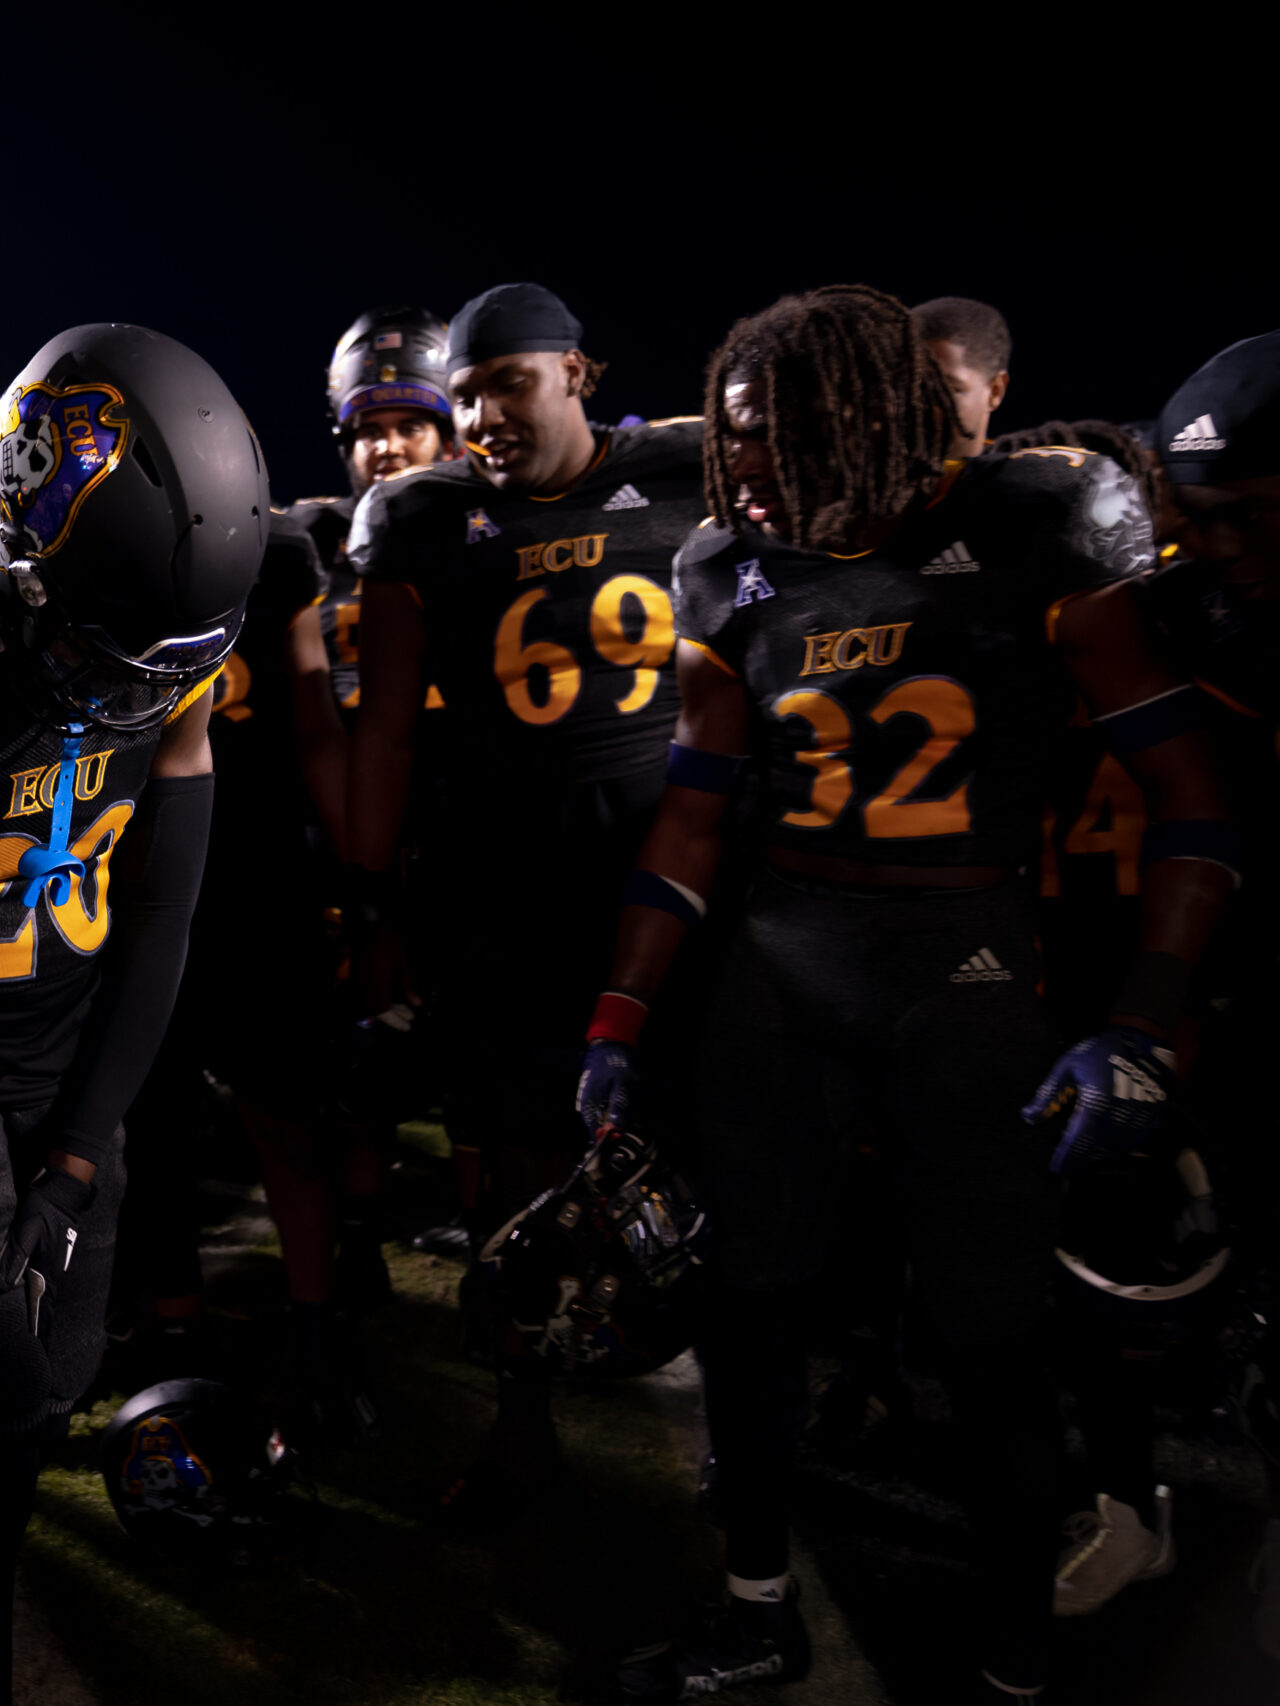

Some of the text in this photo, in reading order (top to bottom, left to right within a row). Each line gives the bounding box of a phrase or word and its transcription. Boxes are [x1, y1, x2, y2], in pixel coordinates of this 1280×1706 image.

[372, 387, 438, 405] QUARTER
[63, 402, 99, 457] ECU
[1168, 439, 1227, 452] adidas
[601, 497, 651, 511] adidas
[514, 532, 610, 582] ECU
[920, 561, 983, 576] adidas
[493, 571, 677, 726] 69
[797, 621, 914, 677] ECU
[771, 673, 978, 842] 32
[947, 969, 1015, 984] adidas
